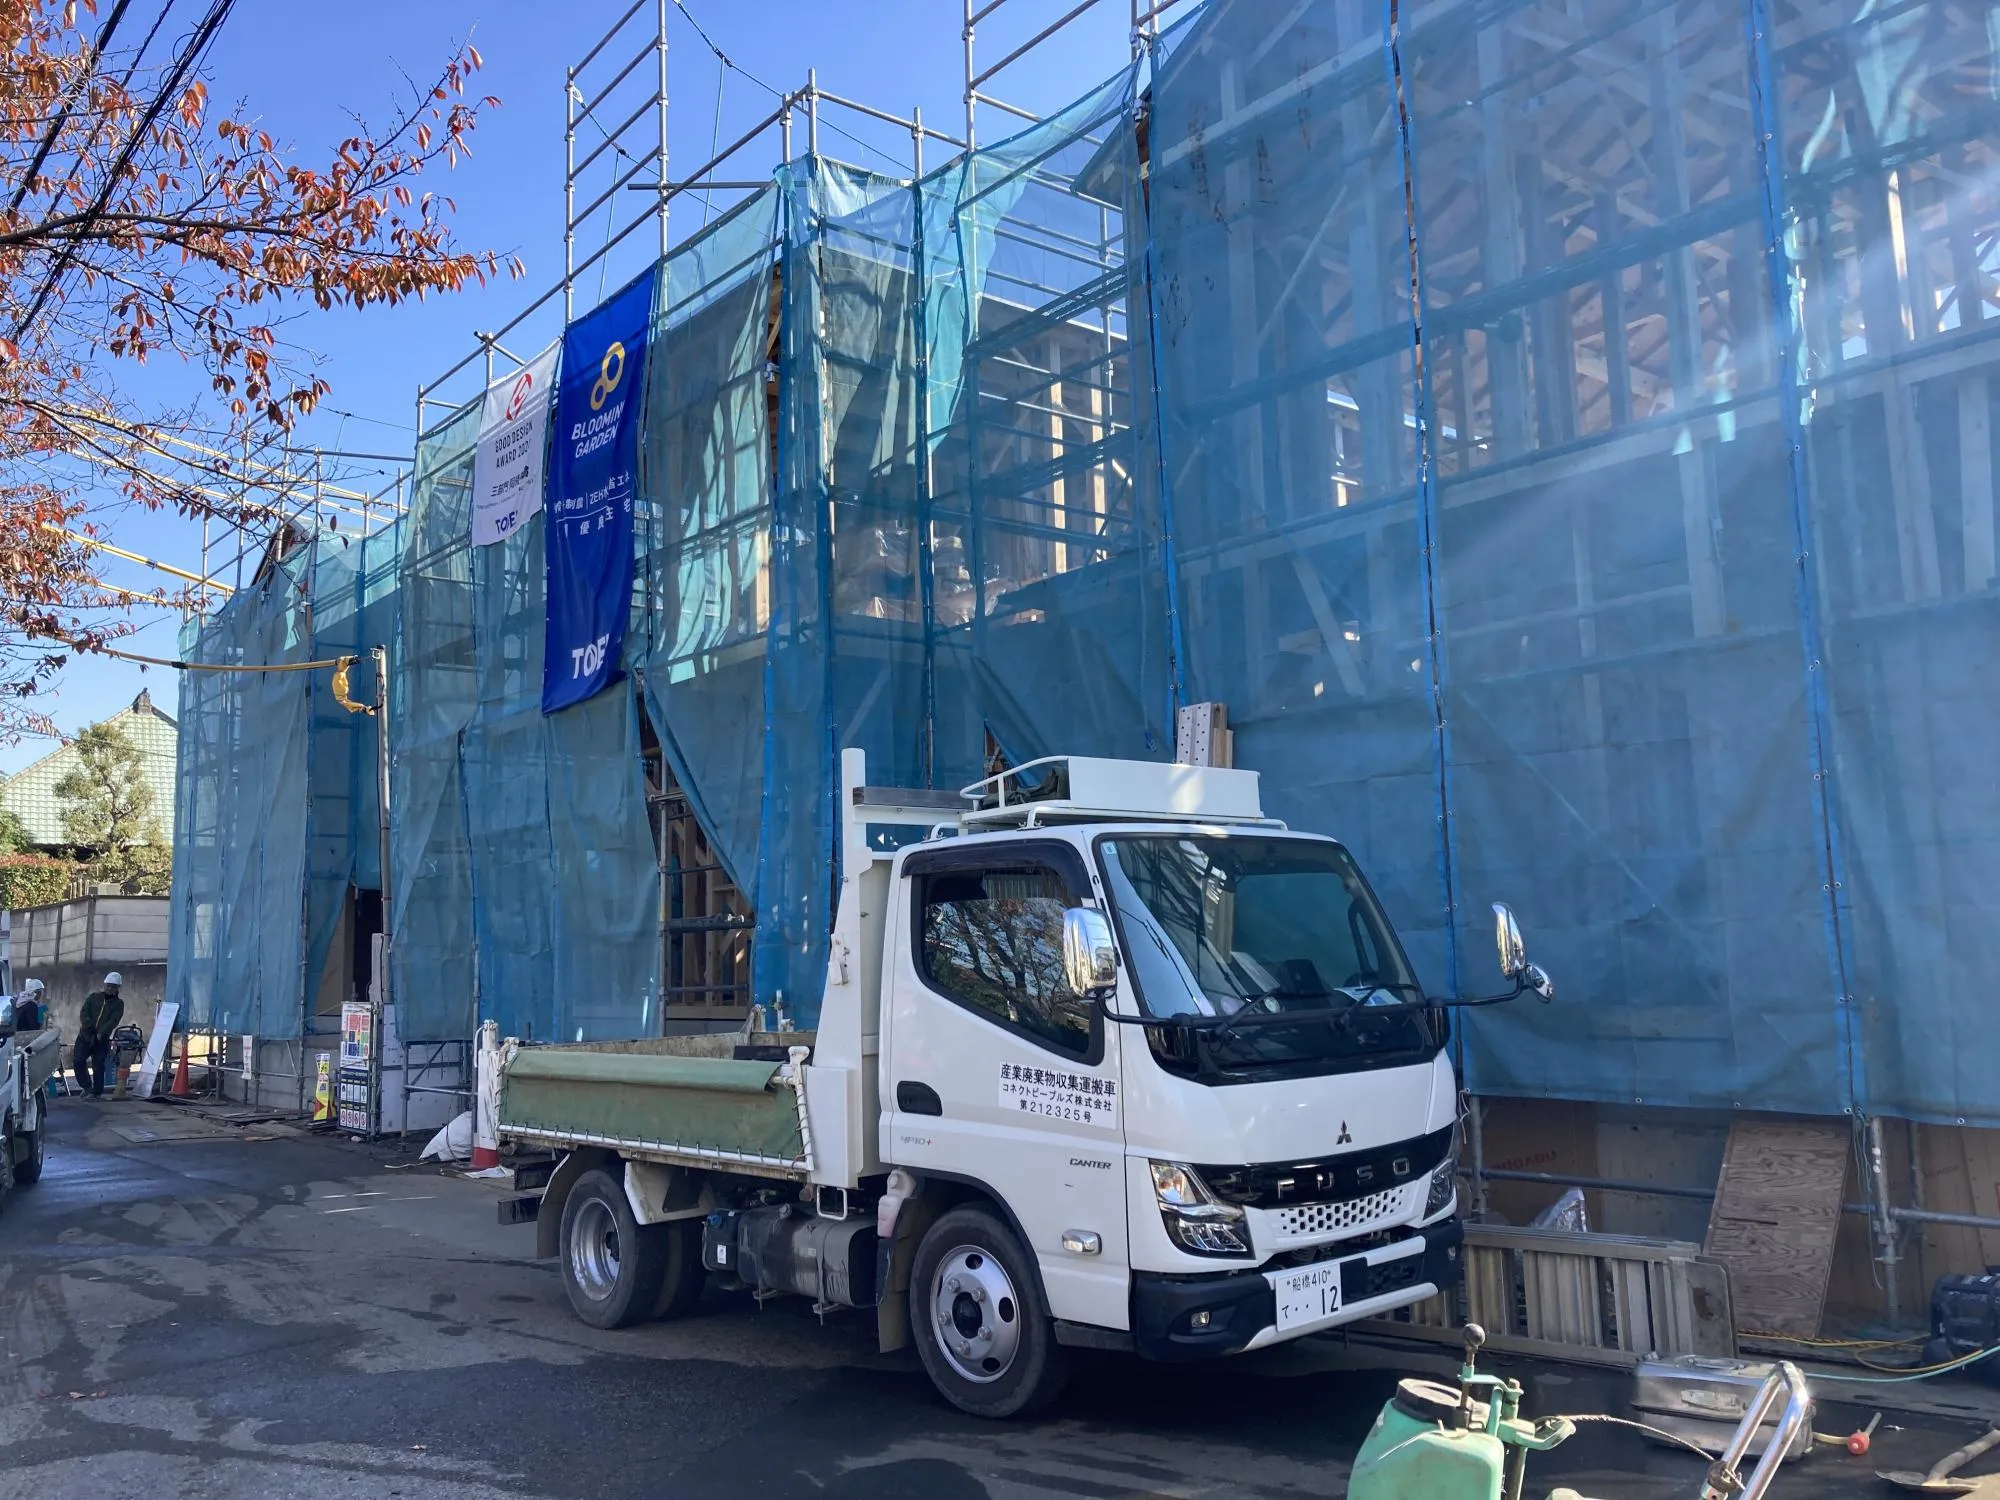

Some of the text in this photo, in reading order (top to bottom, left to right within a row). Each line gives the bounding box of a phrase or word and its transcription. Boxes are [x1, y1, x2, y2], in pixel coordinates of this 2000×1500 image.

[495, 421, 533, 453] GOOD DESIGN
[575, 422, 619, 458] GARDEN
[496, 448, 517, 469] AWARD
[1000, 1063, 1116, 1097] 産業廃棄物収集運搬車
[1020, 1099, 1092, 1123] 第212325号
[1069, 1158, 1112, 1170] CANTER
[1277, 1158, 1410, 1200] FUSO
